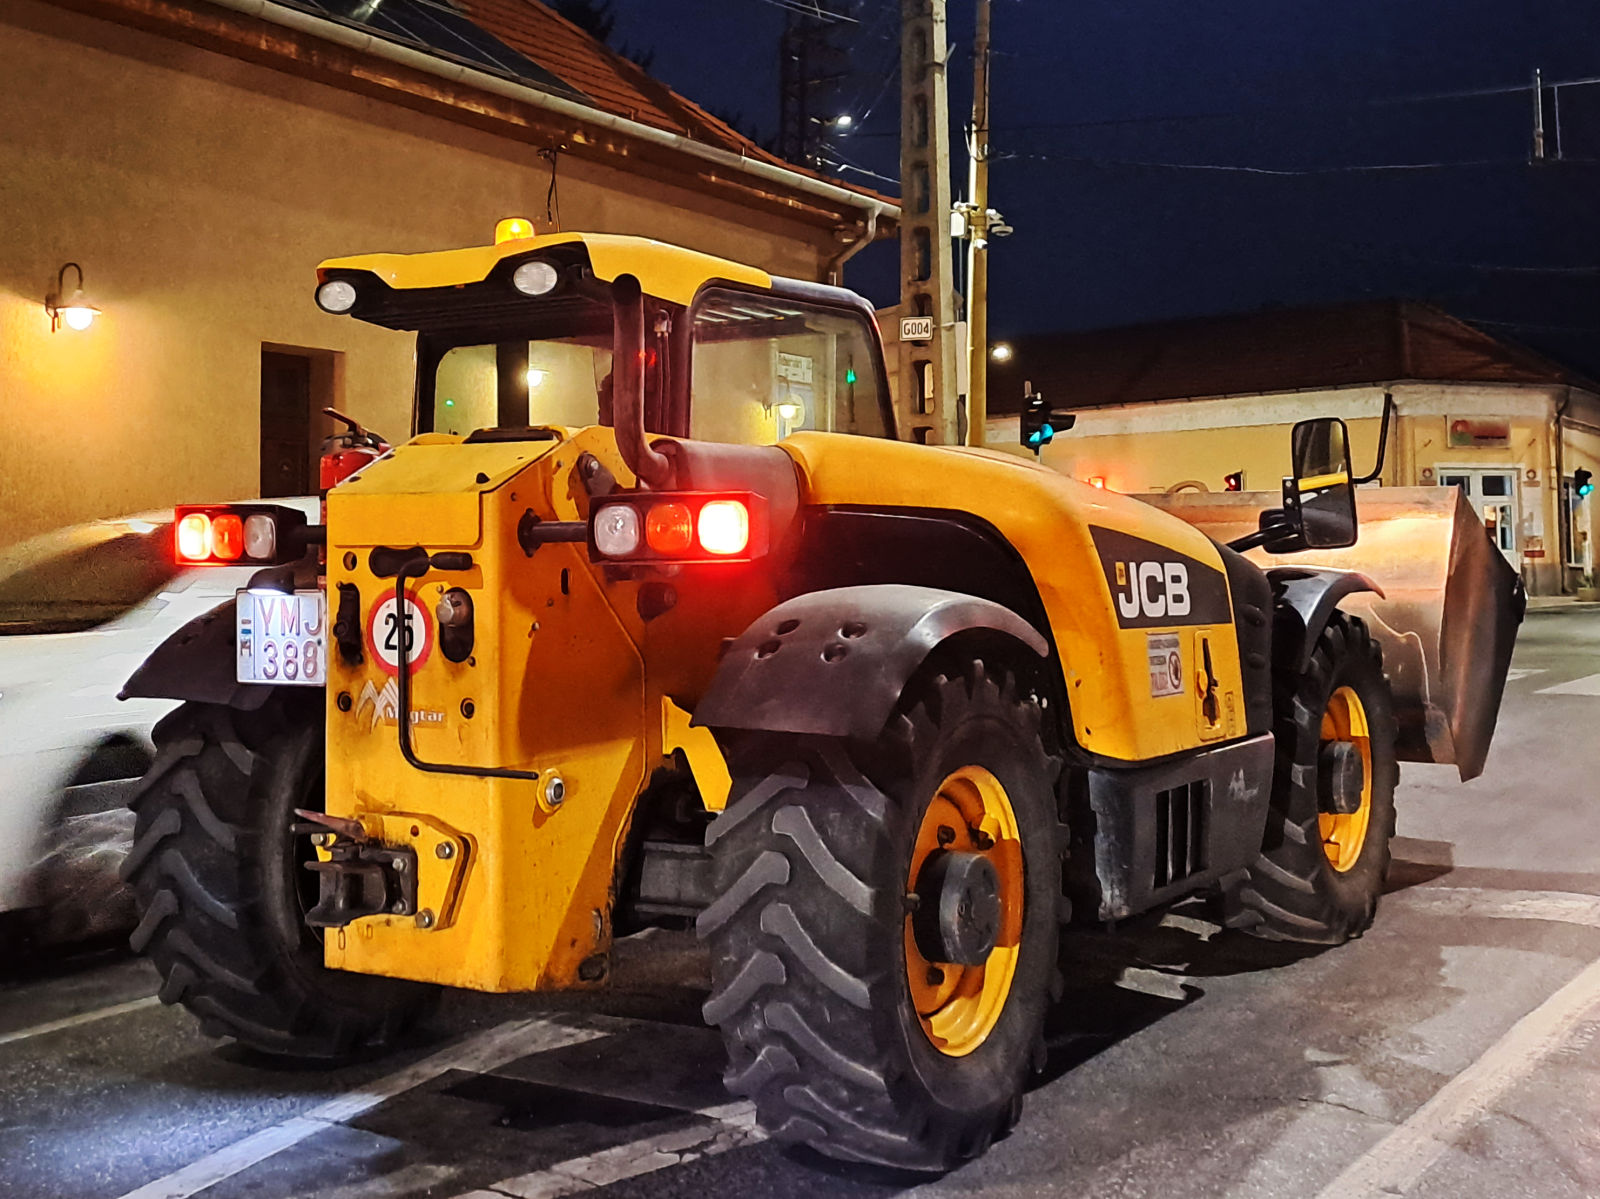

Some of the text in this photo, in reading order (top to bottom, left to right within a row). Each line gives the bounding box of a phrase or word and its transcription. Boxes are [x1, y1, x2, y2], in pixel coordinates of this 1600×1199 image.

[903, 322, 930, 336] G004
[1118, 561, 1191, 619] JCB
[258, 597, 323, 637] YMJ
[384, 612, 414, 652] 25
[262, 640, 318, 681] 388
[385, 706, 446, 724] Mgtár
